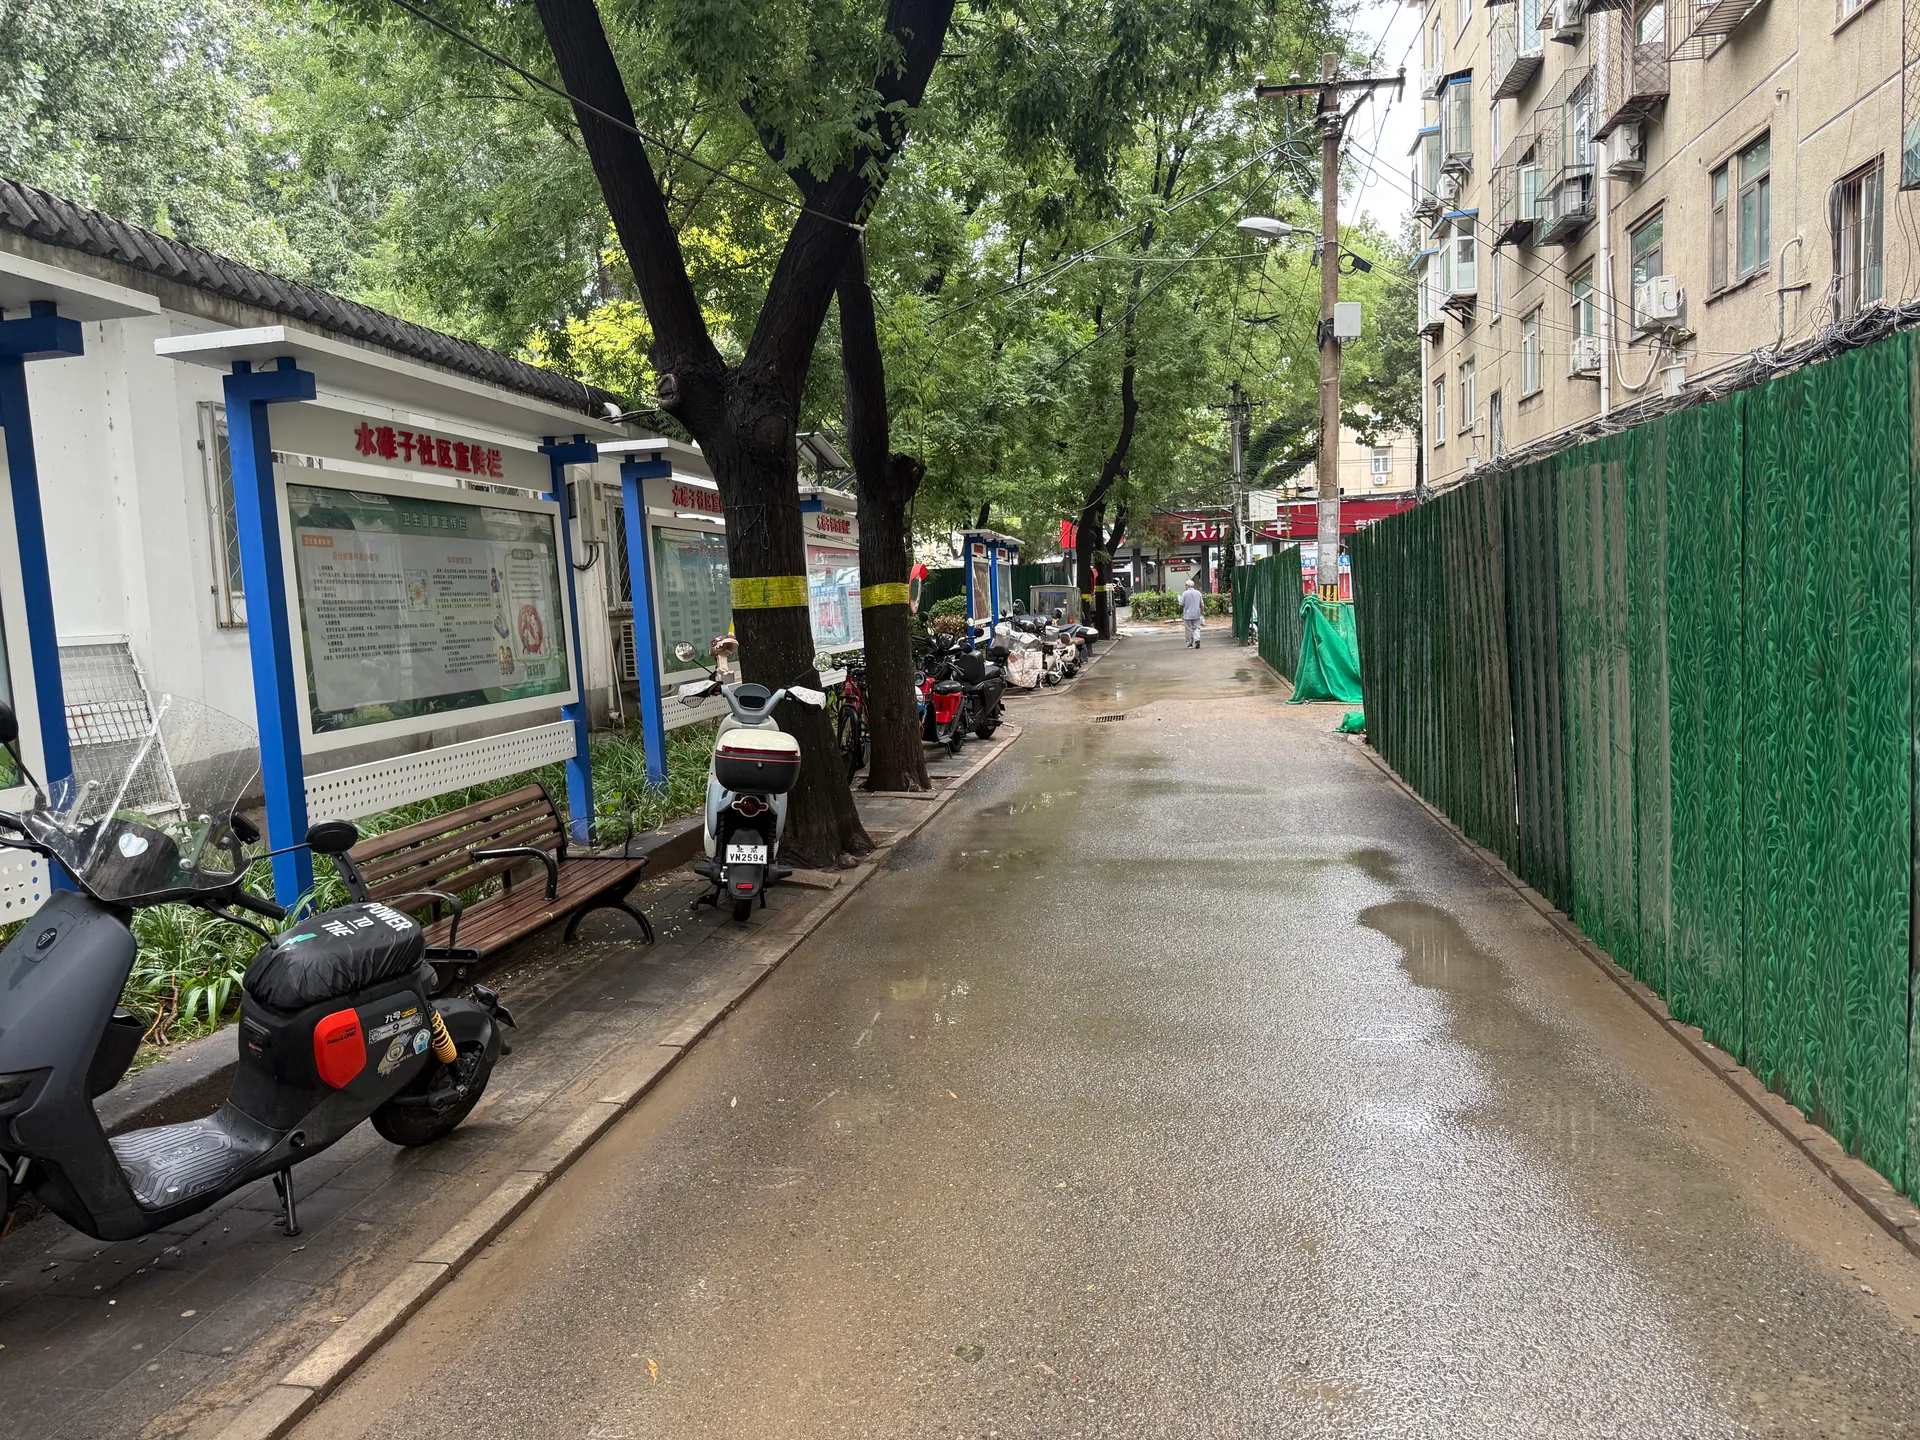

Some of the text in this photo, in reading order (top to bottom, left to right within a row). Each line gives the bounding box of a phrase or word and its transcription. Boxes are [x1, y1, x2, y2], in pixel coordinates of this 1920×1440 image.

[354, 421, 504, 478] 水碓子社区宣传栏
[402, 512, 468, 531] 卫生健康宣传栏
[1182, 514, 1292, 541] 京东车
[353, 915, 374, 928] TO
[362, 902, 413, 932] POWER
[320, 920, 357, 937] THE
[385, 1010, 401, 1023] 九号
